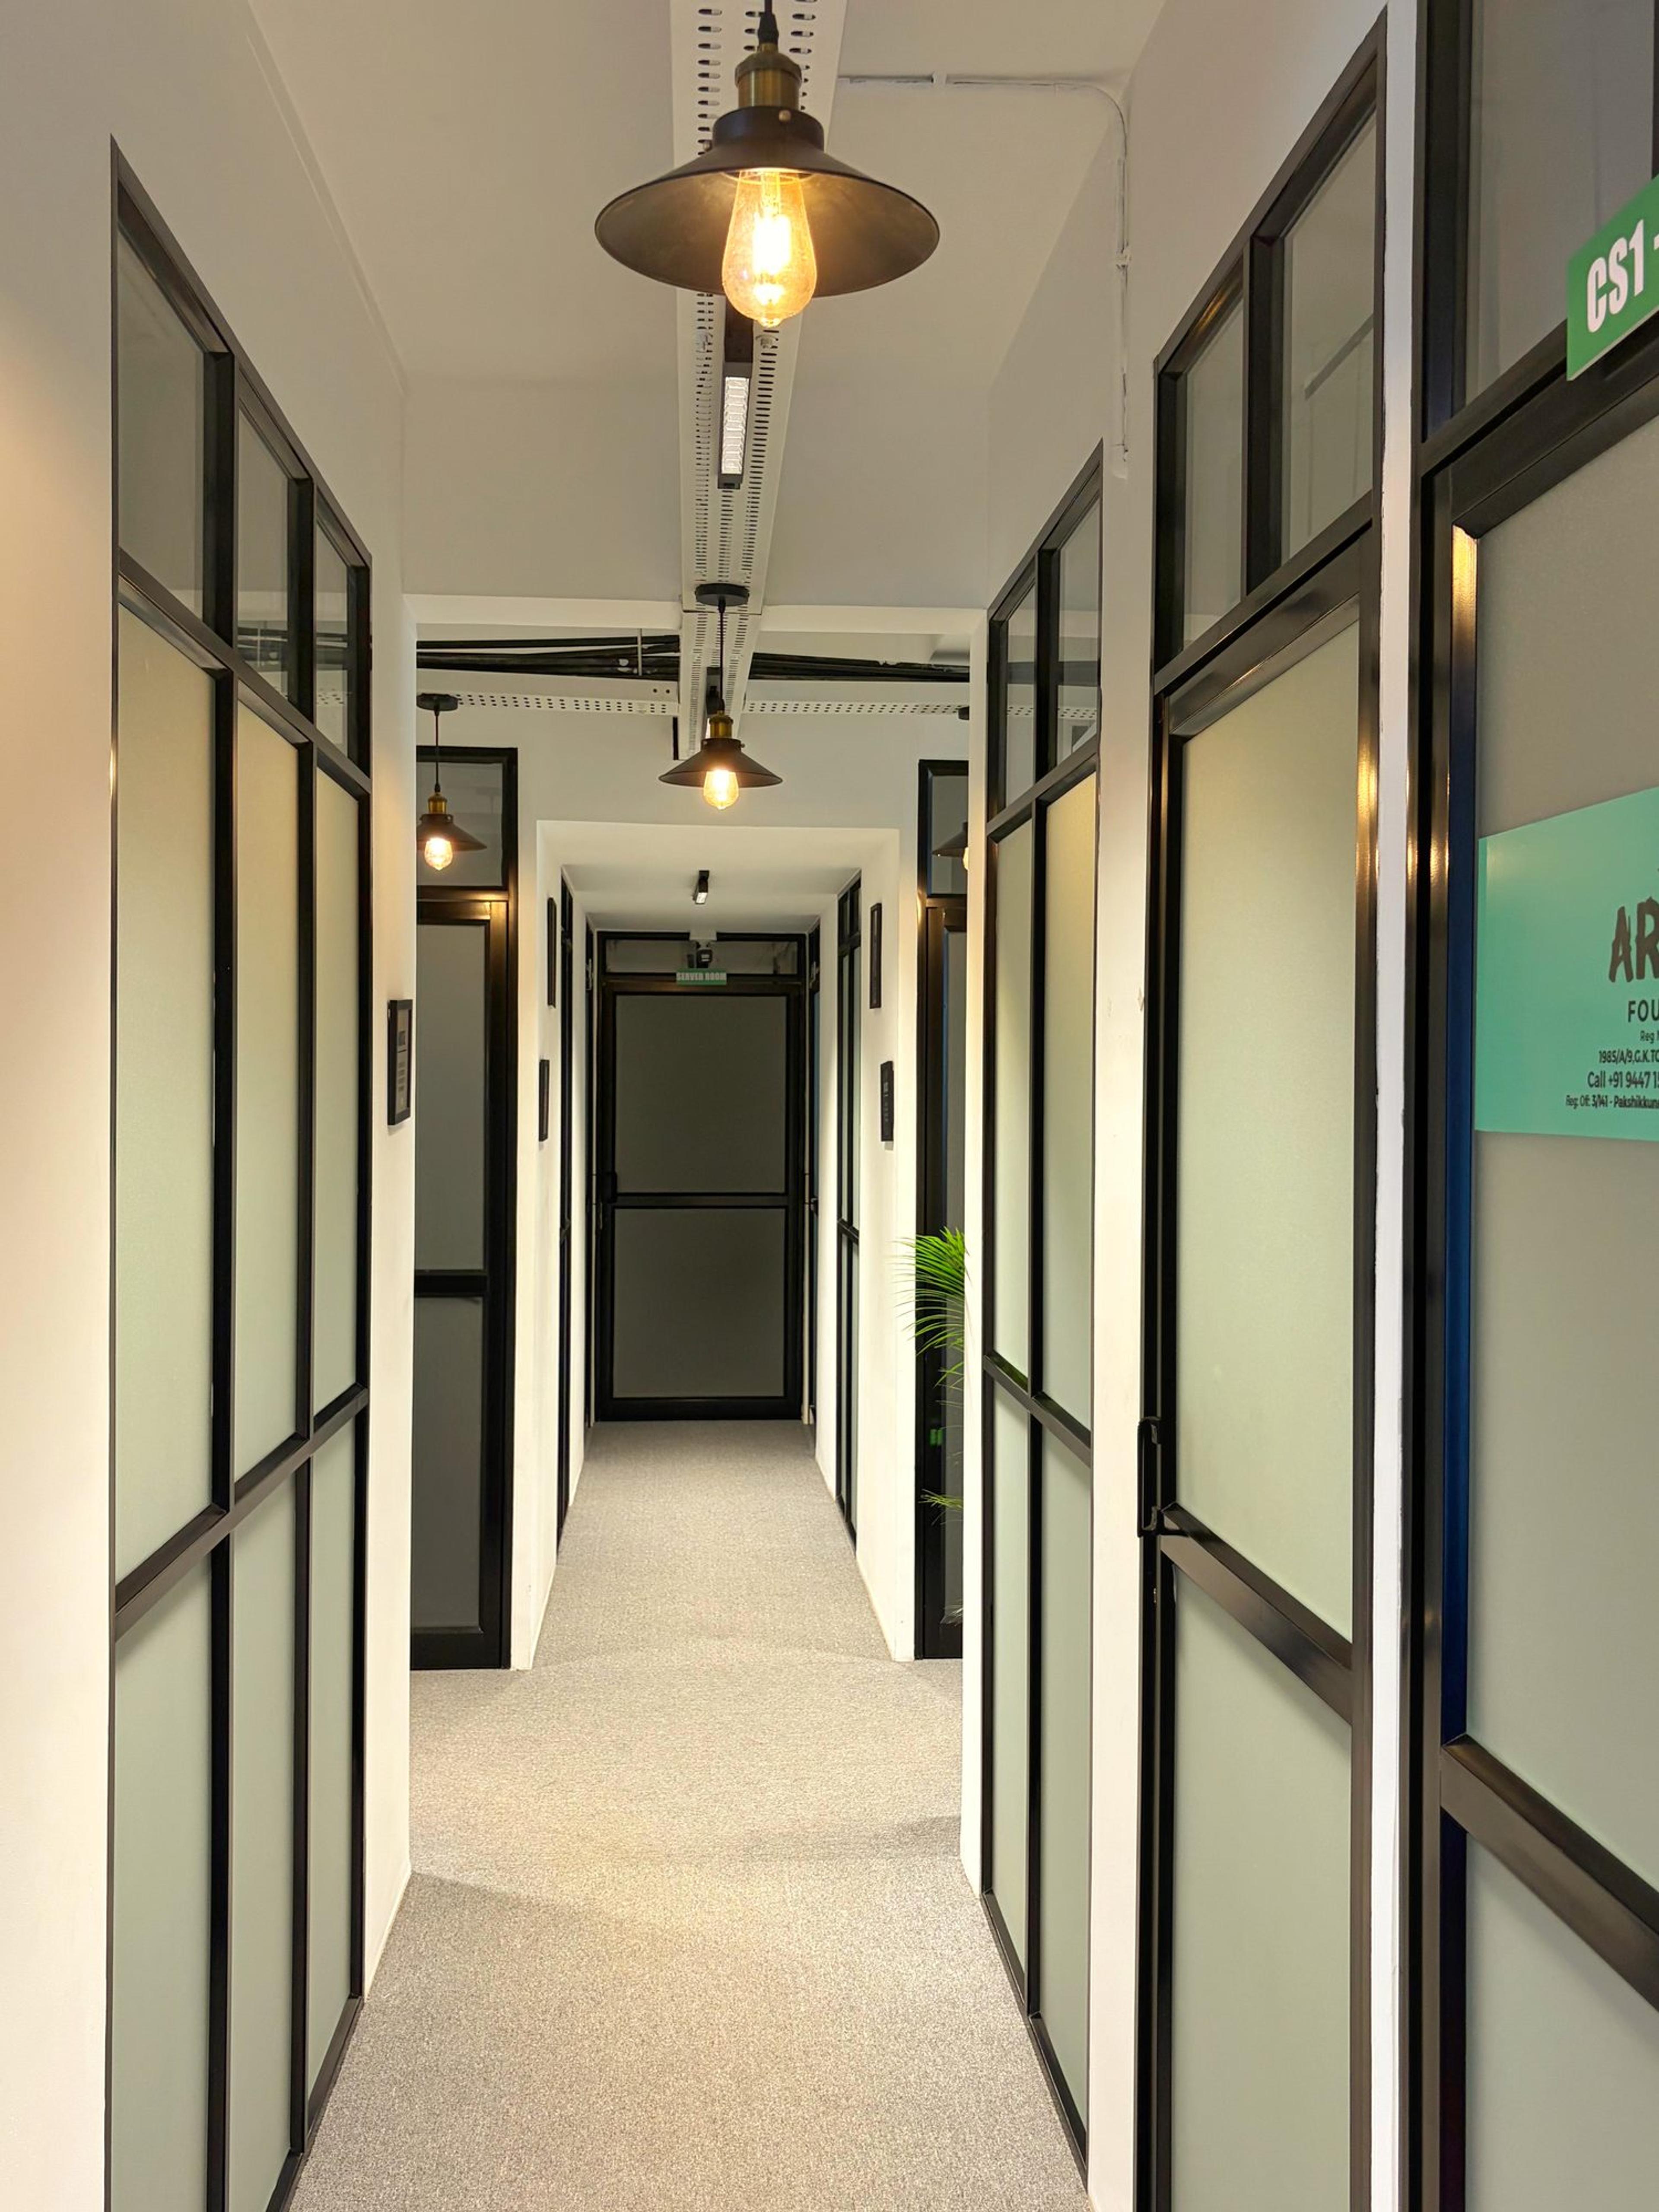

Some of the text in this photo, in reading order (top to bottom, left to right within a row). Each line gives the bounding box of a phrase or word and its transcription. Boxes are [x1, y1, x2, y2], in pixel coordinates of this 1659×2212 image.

[1587, 219, 1643, 333] CS1
[676, 972, 726, 981] SERVER ROOM
[1587, 1070, 1606, 1088] Call
[1608, 1071, 1623, 1088] +91
[1625, 1071, 1651, 1089] 9447
